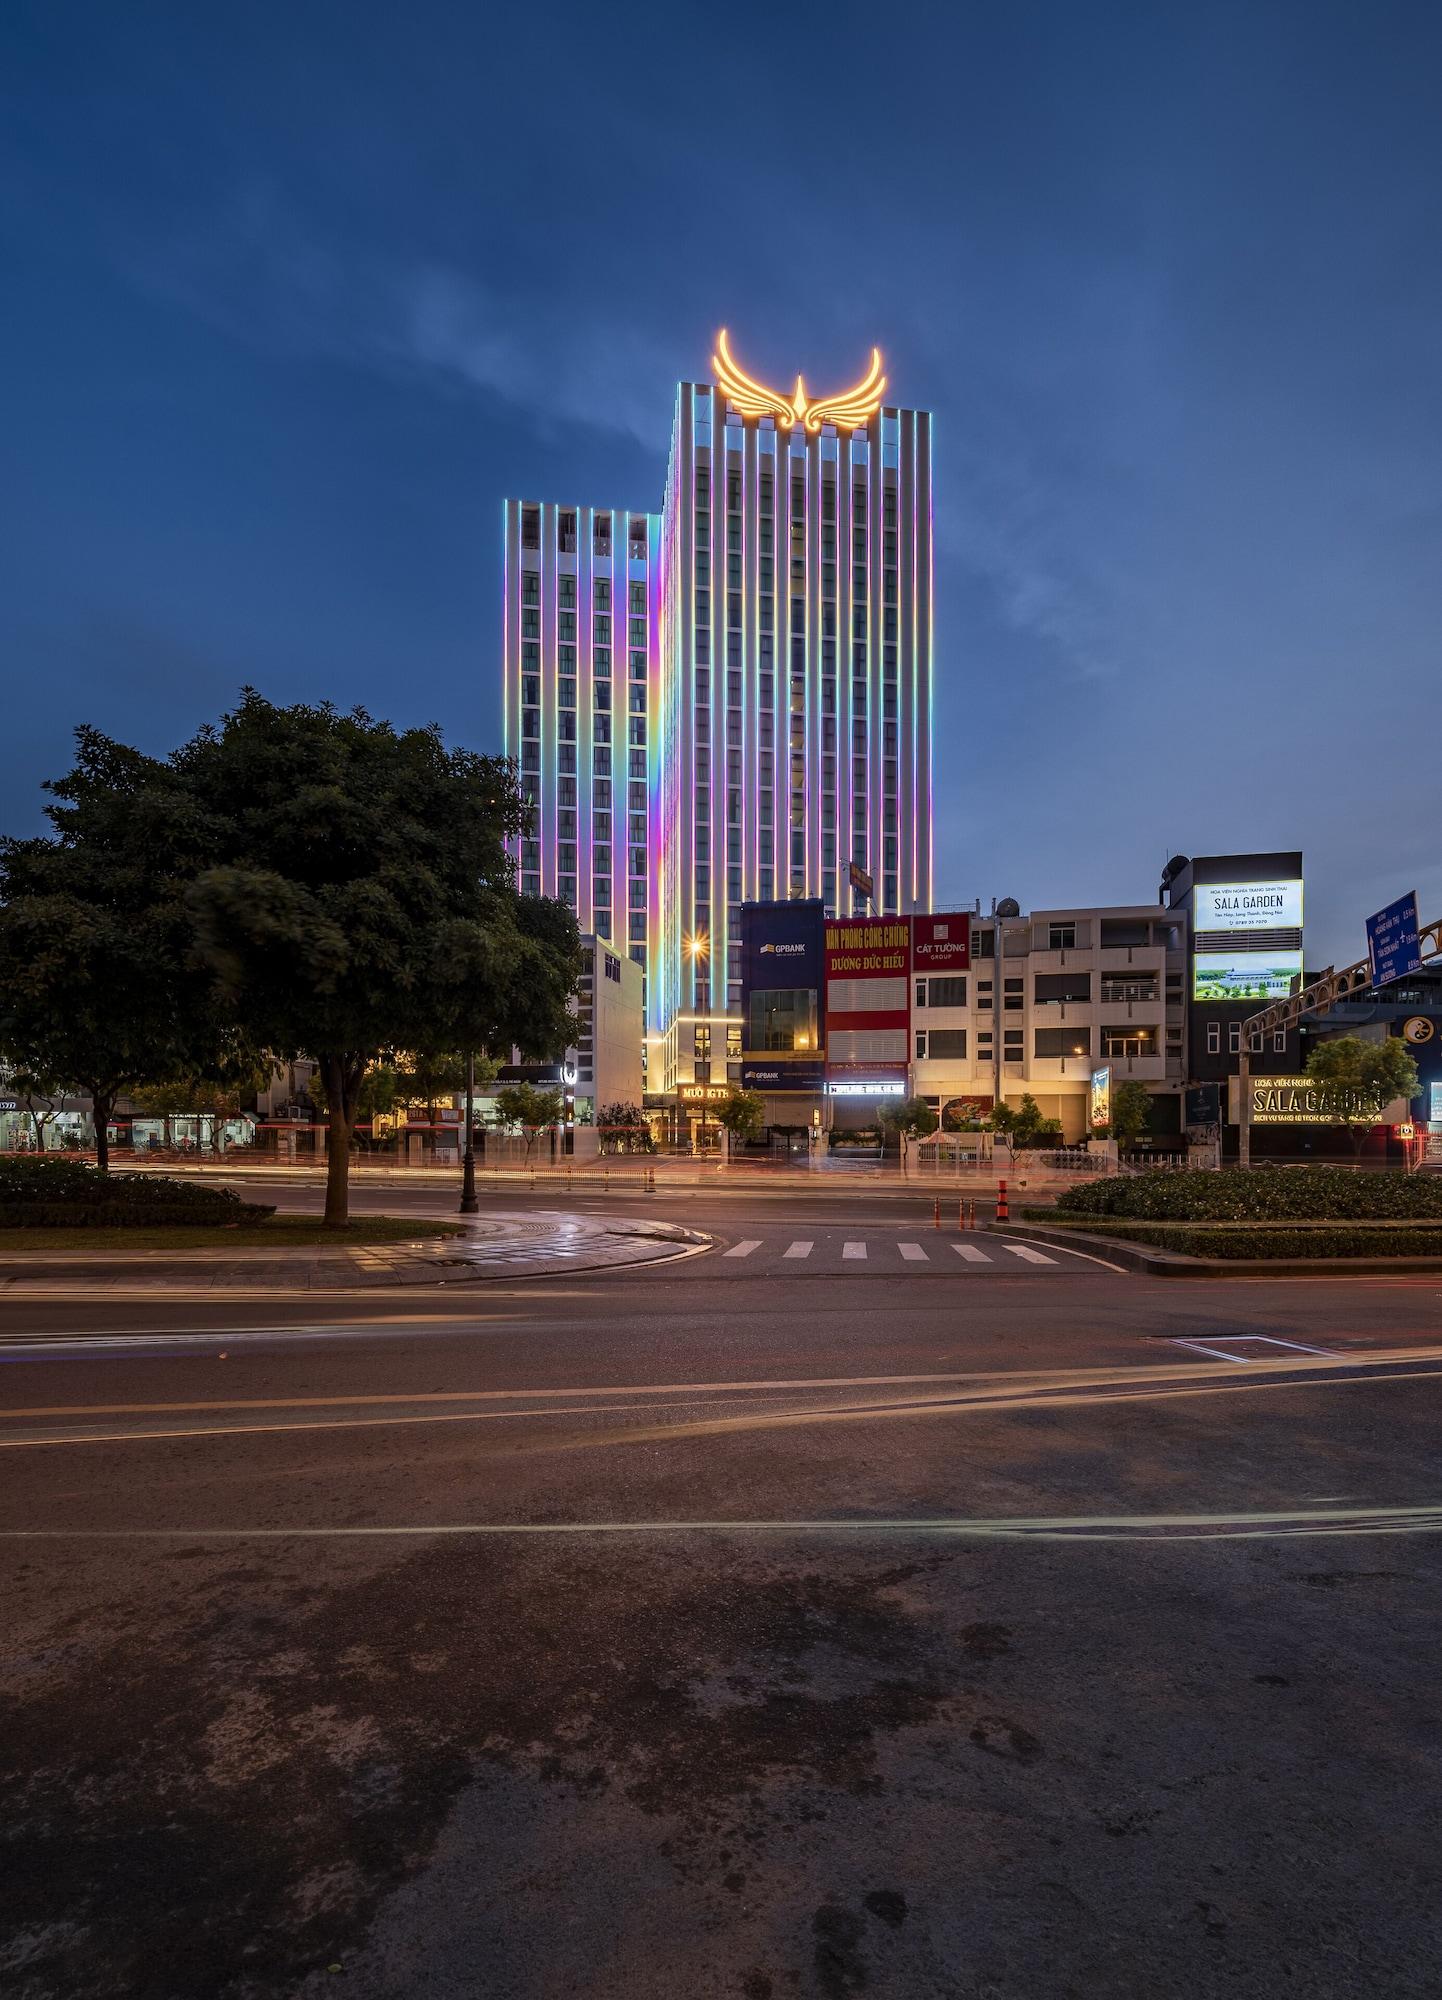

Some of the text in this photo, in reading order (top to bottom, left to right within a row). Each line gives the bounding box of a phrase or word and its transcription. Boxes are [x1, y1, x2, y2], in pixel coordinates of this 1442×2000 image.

[1214, 895, 1283, 910] SALA GARDEN
[826, 922, 909, 950] VĂN PHÒNG CÔNG CHỨNG
[775, 943, 806, 953] GPBANK
[917, 942, 966, 954] CÁT TƯỜNG
[831, 950, 905, 971] DƯƠNG ĐỨC HIẾU
[1253, 1089, 1302, 1112] SALA
